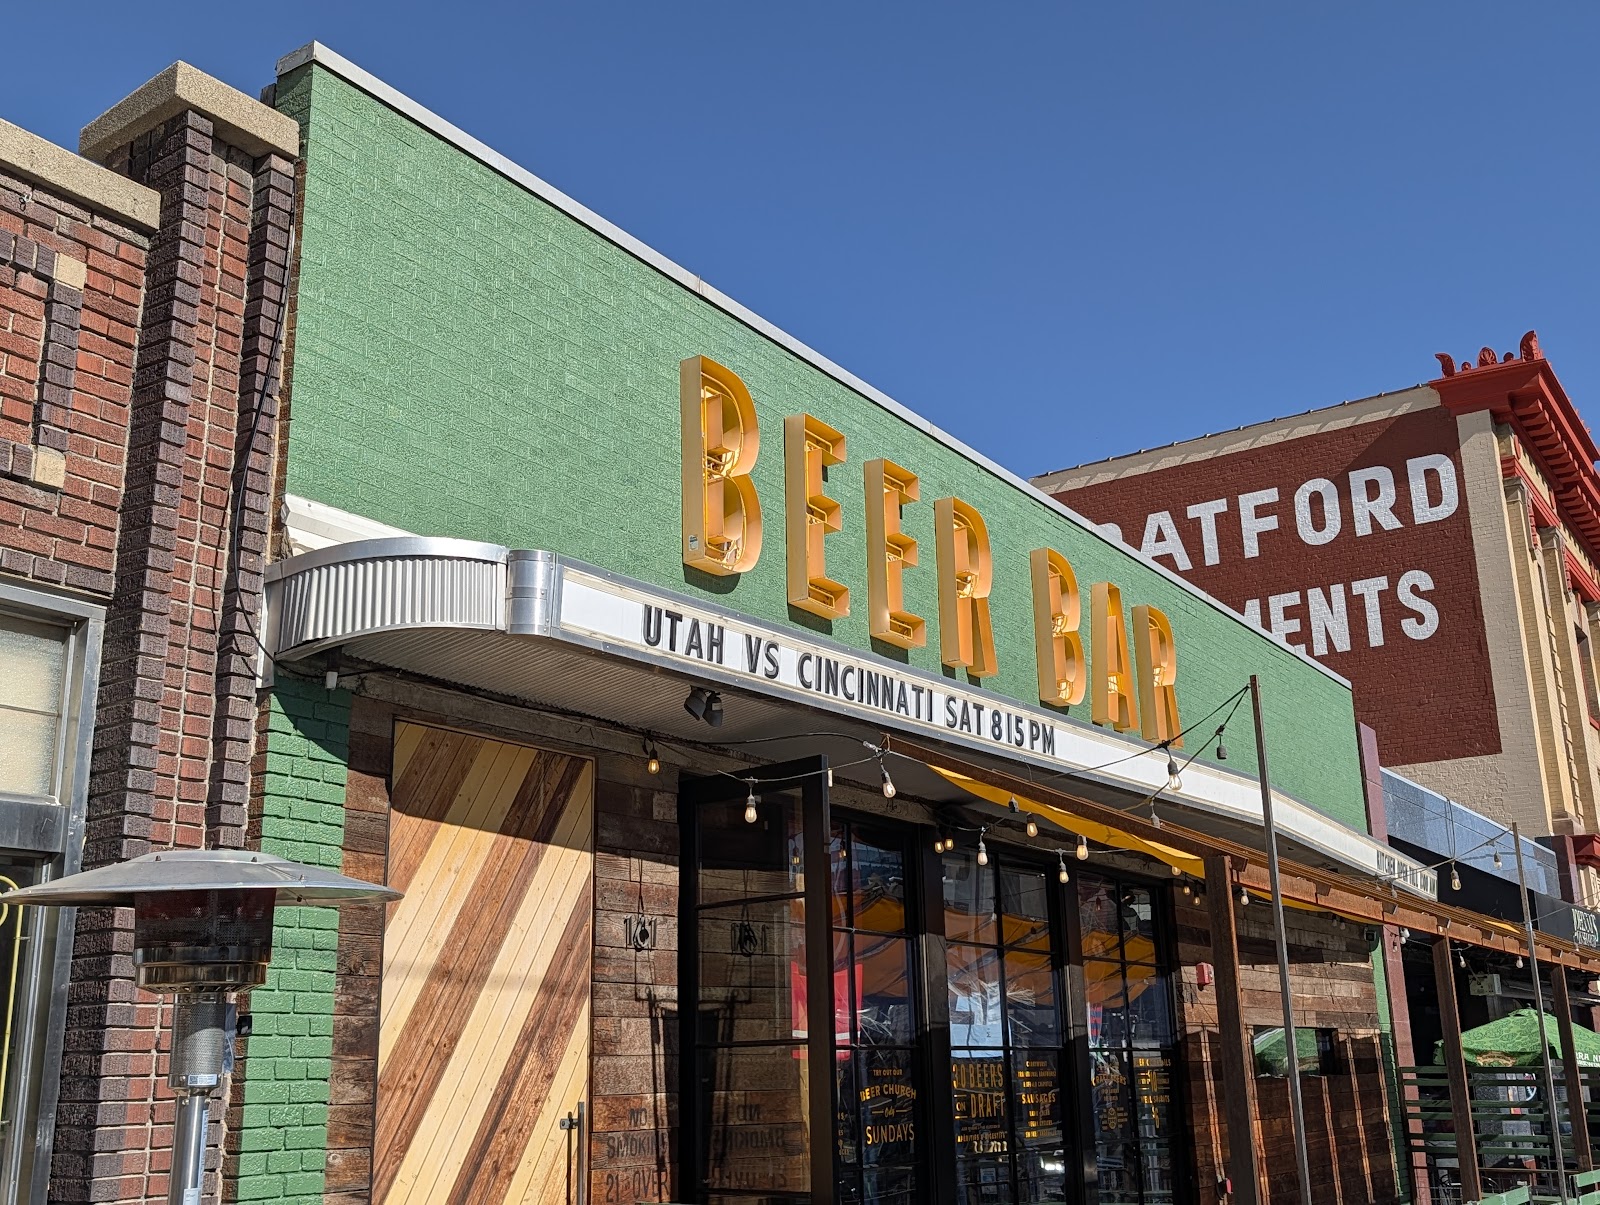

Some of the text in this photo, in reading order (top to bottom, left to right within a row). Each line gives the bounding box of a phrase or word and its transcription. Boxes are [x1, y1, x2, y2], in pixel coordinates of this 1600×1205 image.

[680, 354, 1184, 748] BEER BAR
[643, 604, 724, 665] UTAH
[745, 634, 780, 680] VS
[797, 652, 934, 722] CINCINNATI
[945, 694, 985, 736] SAT
[873, 1069, 882, 1077] TRY
[893, 1068, 903, 1076] OUR
[952, 1063, 1004, 1089] 30 BEERS
[860, 1083, 917, 1102] BEER CHURCH
[1021, 1092, 1056, 1105] SAUSAGES
[970, 1091, 1005, 1119] DRAFT
[629, 1107, 648, 1128] NO
[865, 1123, 915, 1145] SUNDAYS
[606, 1173, 620, 1203] 21
[633, 1167, 670, 1199] OVER
